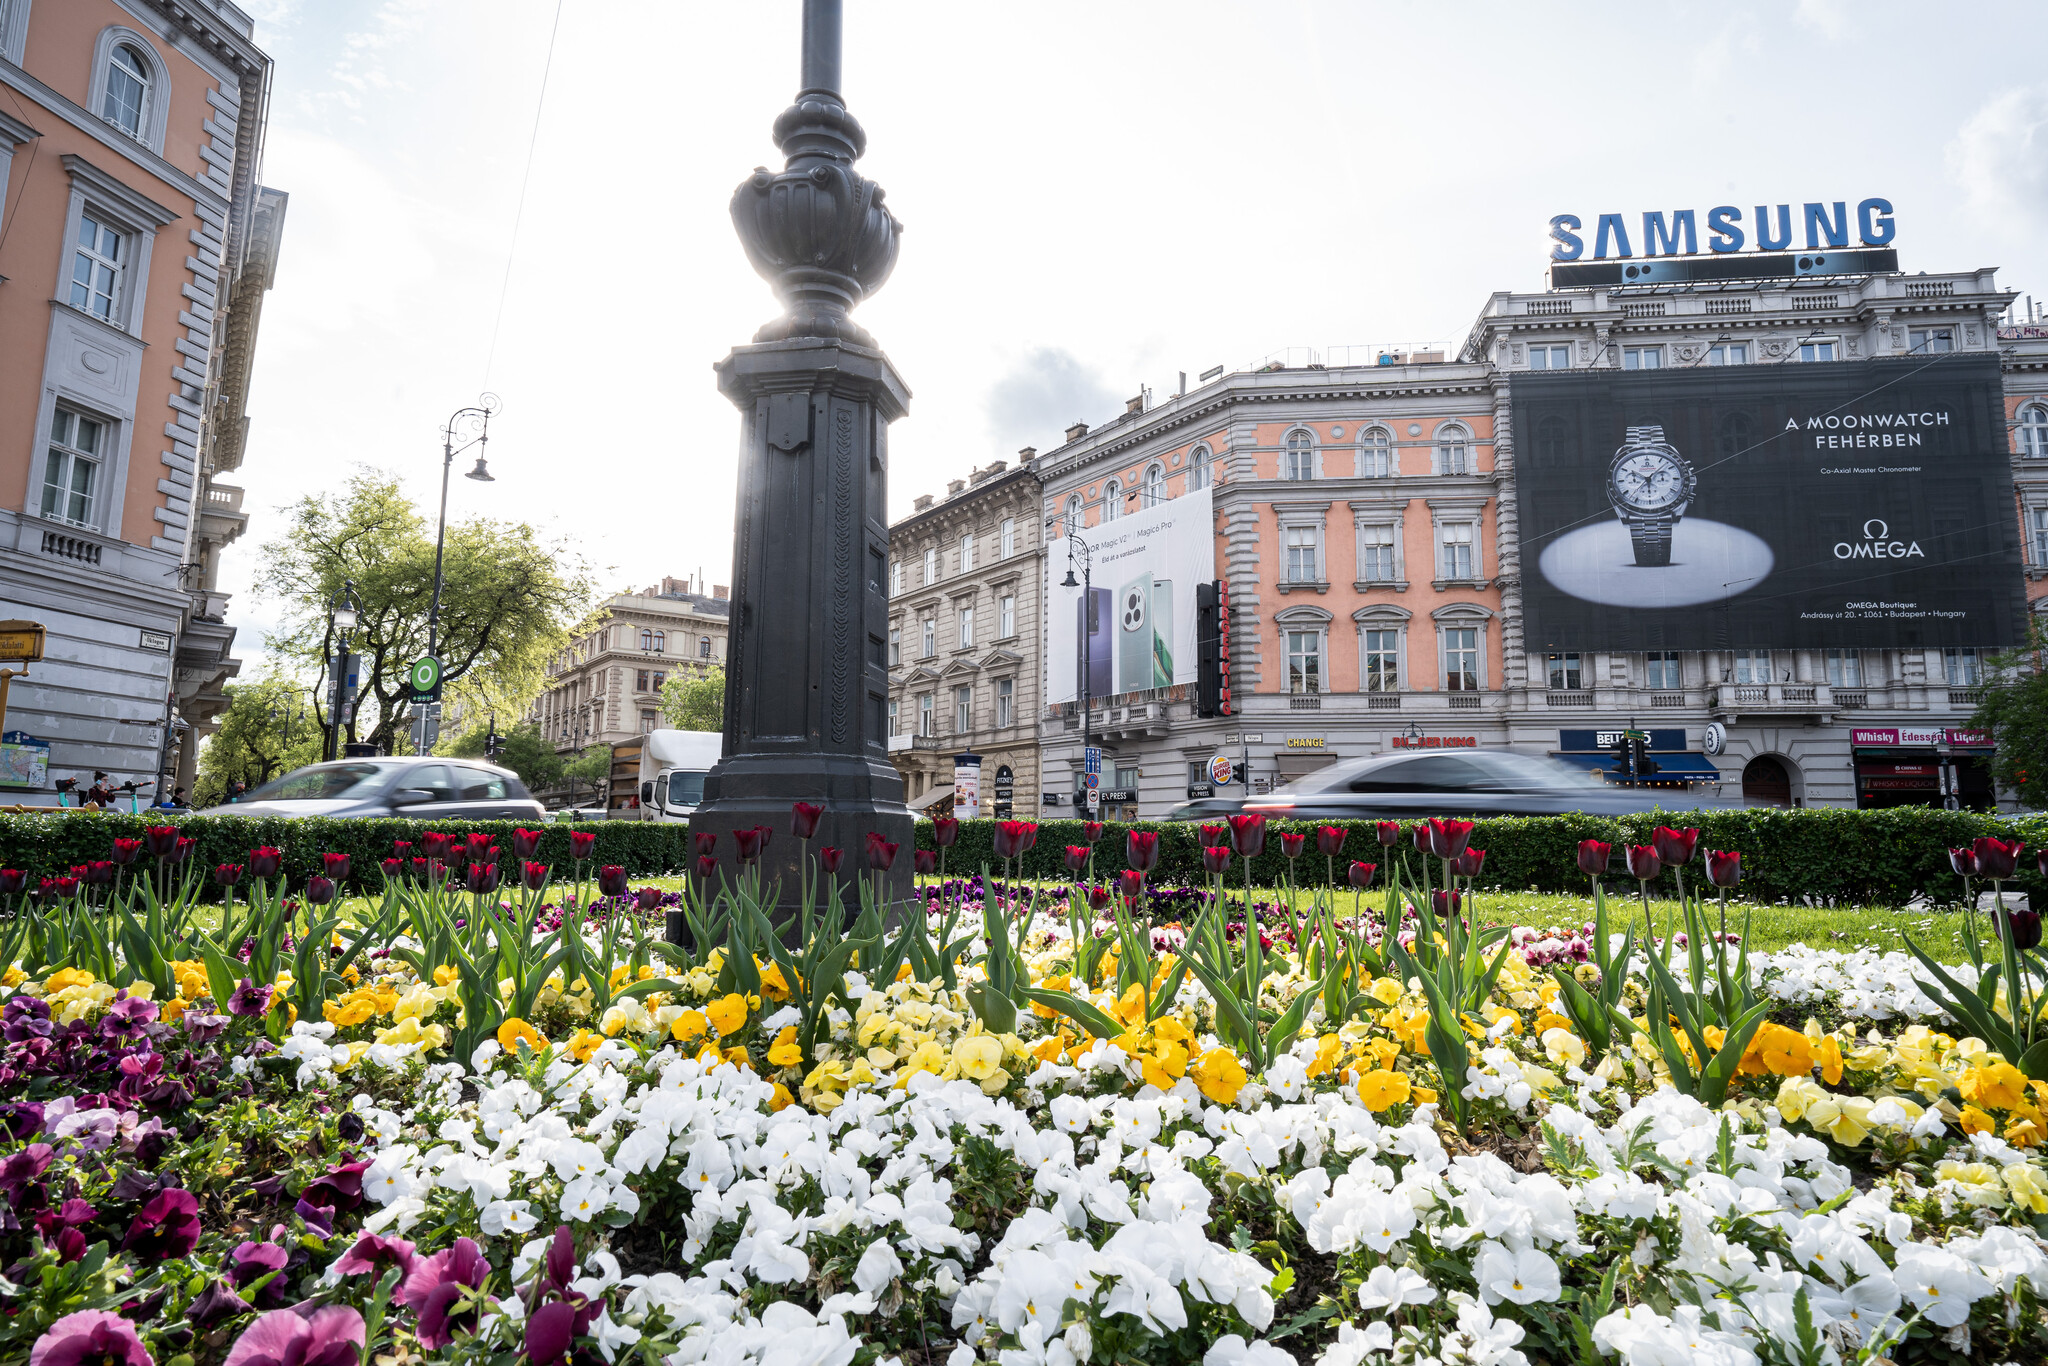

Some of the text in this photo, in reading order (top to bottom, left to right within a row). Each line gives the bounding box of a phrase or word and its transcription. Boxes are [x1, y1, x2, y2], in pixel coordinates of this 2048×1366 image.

[1549, 197, 1896, 261] SAMSUNG
[1785, 412, 1949, 430] A MOONWATCH
[1815, 432, 1921, 449] FEHÉRBEN
[1820, 467, 1851, 475] Co-Axial
[1100, 540, 1119, 549] Magic
[1119, 535, 1127, 544] V2
[1137, 525, 1160, 538] Magic6
[1160, 521, 1172, 532] Pro
[1833, 541, 1925, 559] OMEGA
[1880, 601, 1917, 610] Boutique:
[1800, 611, 1833, 620] Andrássy
[1890, 610, 1926, 619] Budapest
[1933, 610, 1966, 619] Hungary
[1219, 580, 1231, 716] BURGER KING
[1287, 737, 1324, 748] CHANGE
[1392, 736, 1477, 748] BUGER KING
[1856, 731, 1895, 744] Whisky
[1212, 761, 1230, 772] BURGER
[1213, 766, 1231, 780] KING
[1904, 780, 1934, 788] LIQUOR
